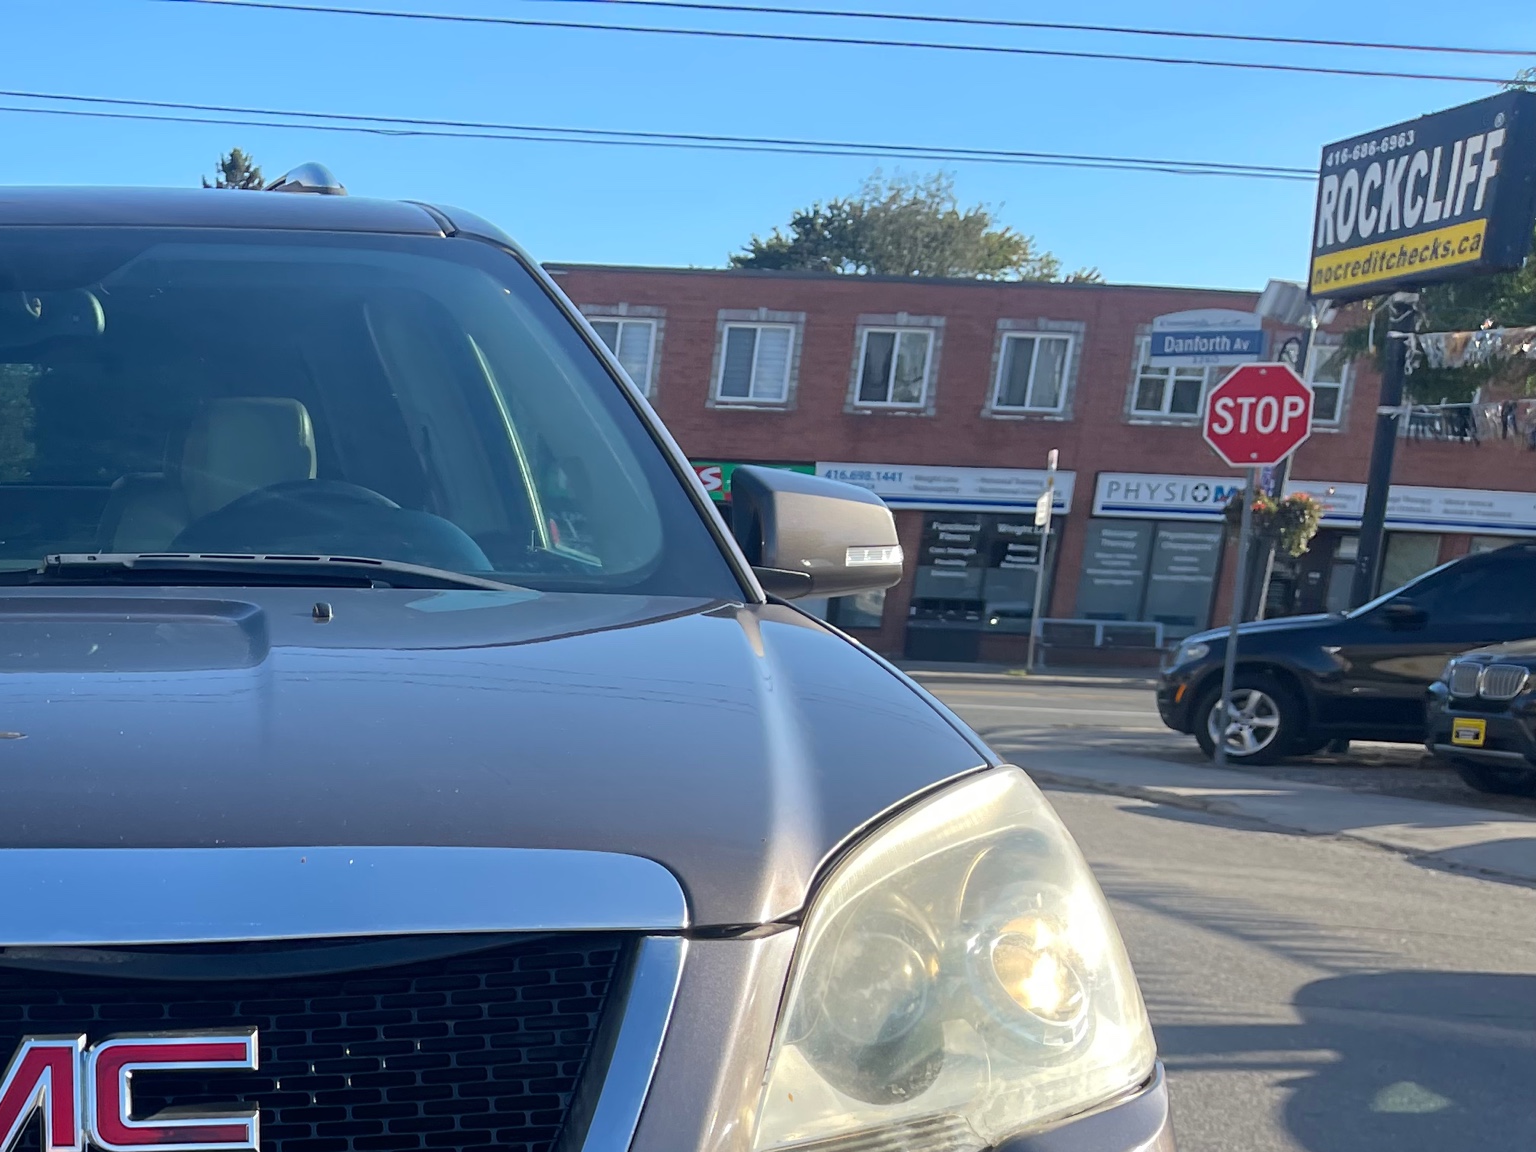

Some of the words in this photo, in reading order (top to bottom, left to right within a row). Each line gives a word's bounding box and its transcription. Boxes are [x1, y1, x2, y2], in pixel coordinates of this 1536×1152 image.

[1326, 129, 1415, 168] 416-686-6963
[1316, 128, 1506, 249] ROCKCLIFF
[1314, 232, 1482, 286] nocreditchecks.ca
[1164, 335, 1231, 353] Danforth
[1233, 337, 1251, 351] Av
[1212, 396, 1306, 434] STOP
